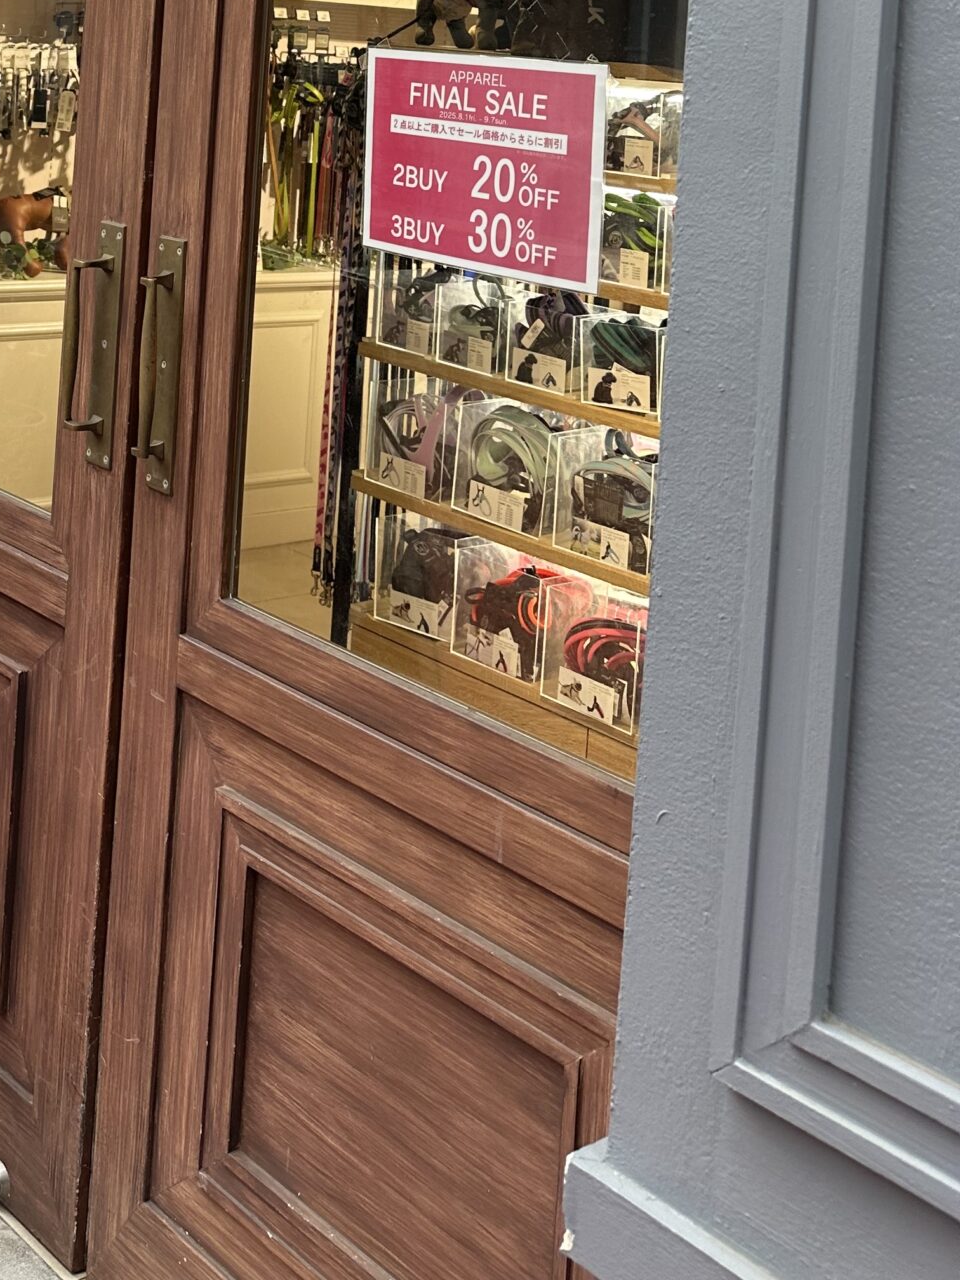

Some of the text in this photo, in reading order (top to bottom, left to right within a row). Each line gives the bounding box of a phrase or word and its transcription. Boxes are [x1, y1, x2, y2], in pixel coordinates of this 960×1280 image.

[409, 81, 549, 121] FINAL SALE
[448, 70, 507, 88] APPAREL
[392, 163, 449, 193] 2BUY
[518, 185, 561, 211] OFF
[390, 214, 445, 246] 3BUY
[514, 240, 558, 267] OFF
